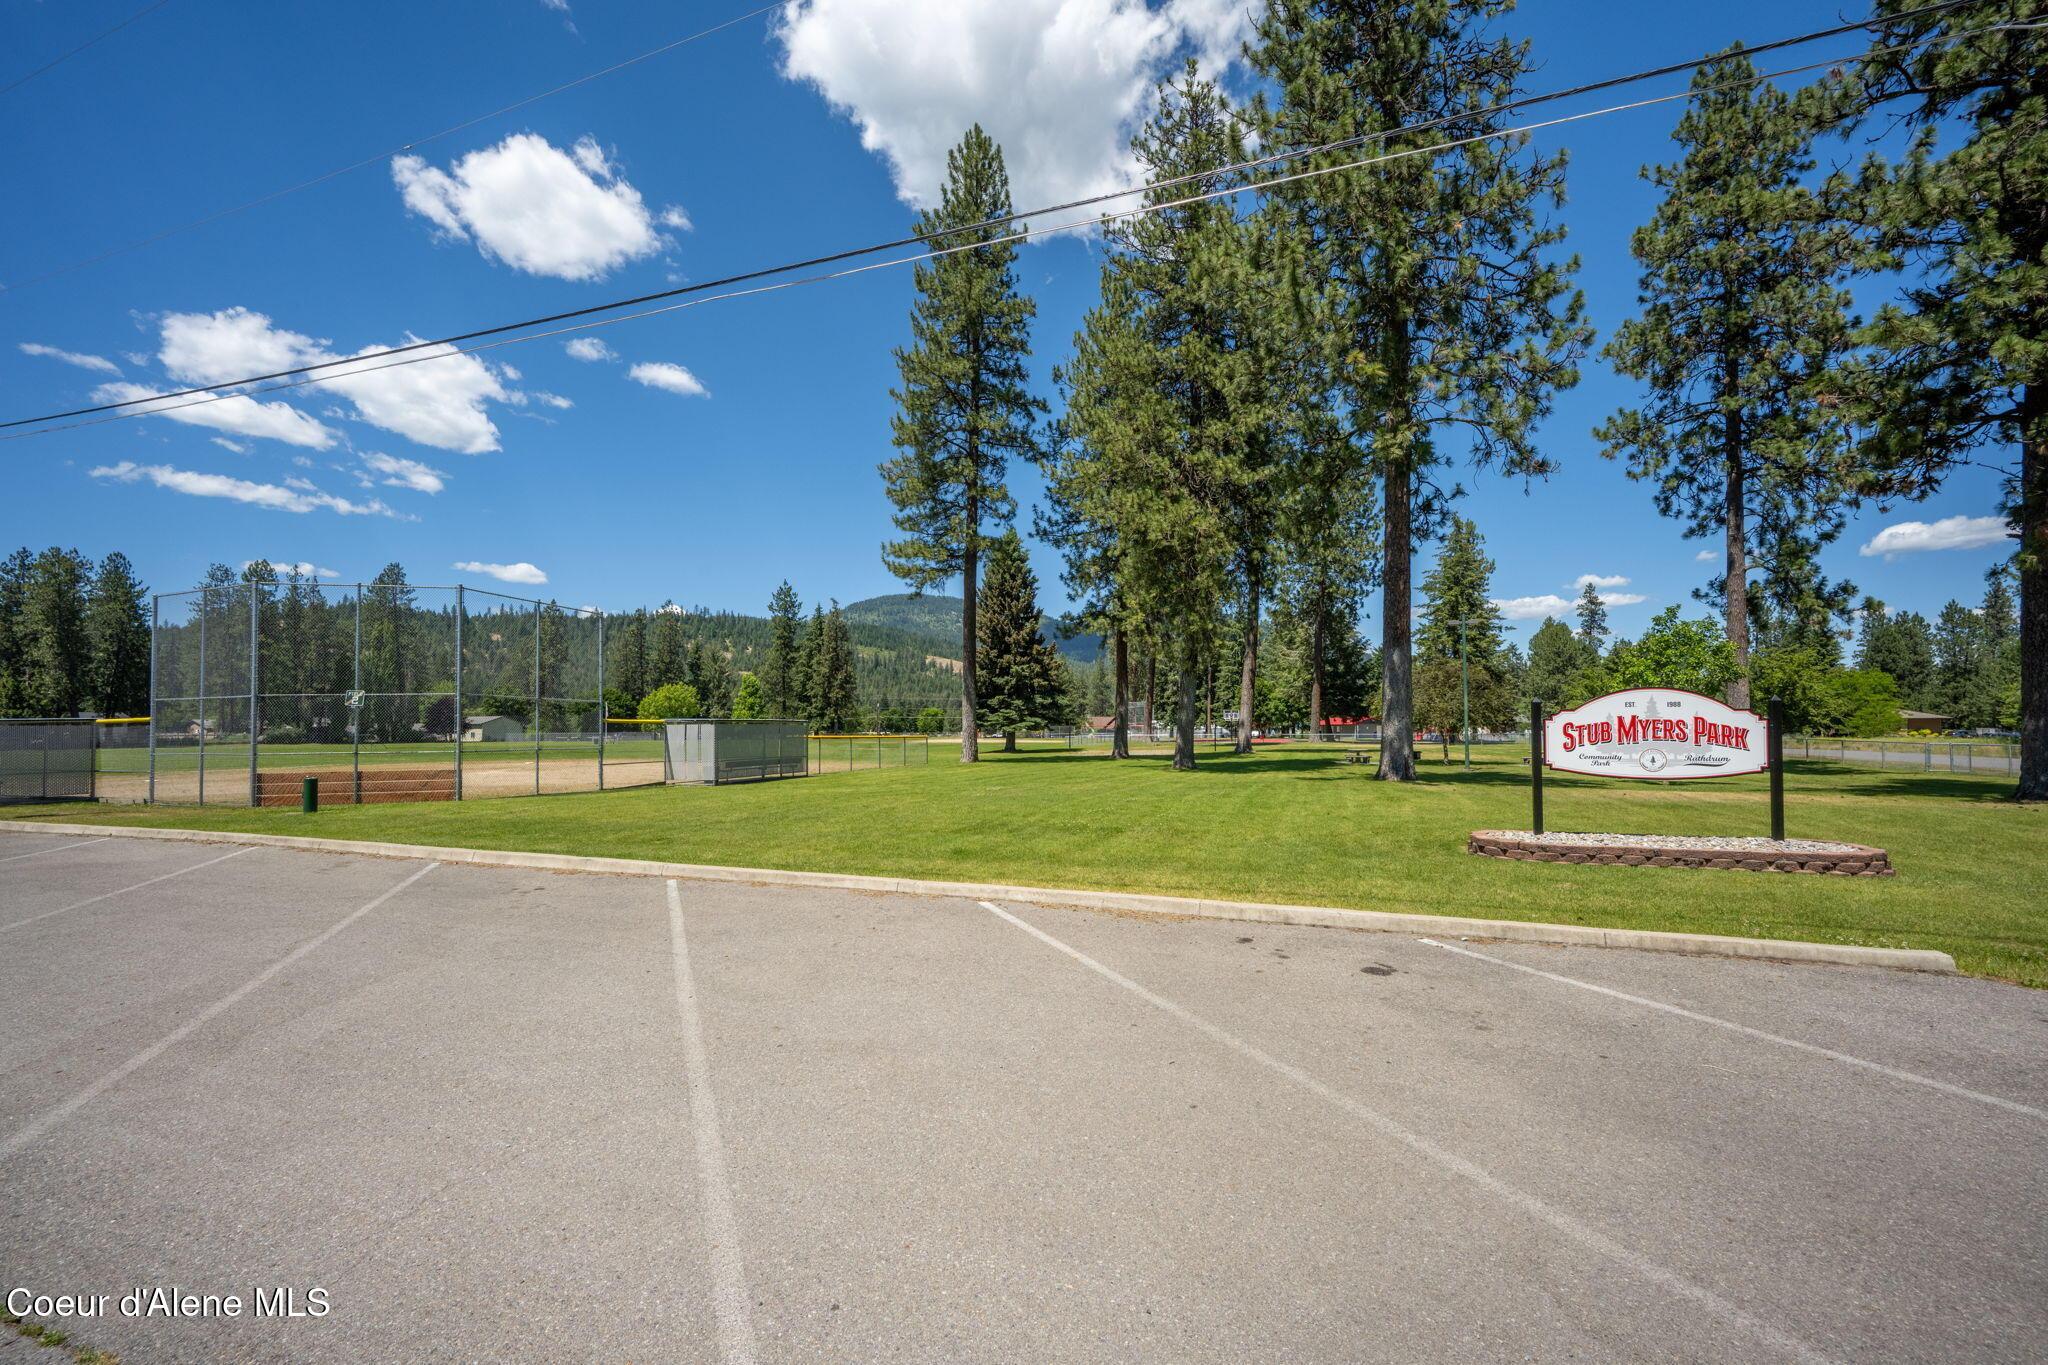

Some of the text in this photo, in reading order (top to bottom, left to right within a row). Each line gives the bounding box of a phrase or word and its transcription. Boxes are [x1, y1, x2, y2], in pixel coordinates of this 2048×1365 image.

[351, 696, 359, 704] 2
[1562, 715, 1750, 752] STUB MYERS PARK
[1578, 753, 1622, 761] Community
[1684, 754, 1730, 763] Rathdrum
